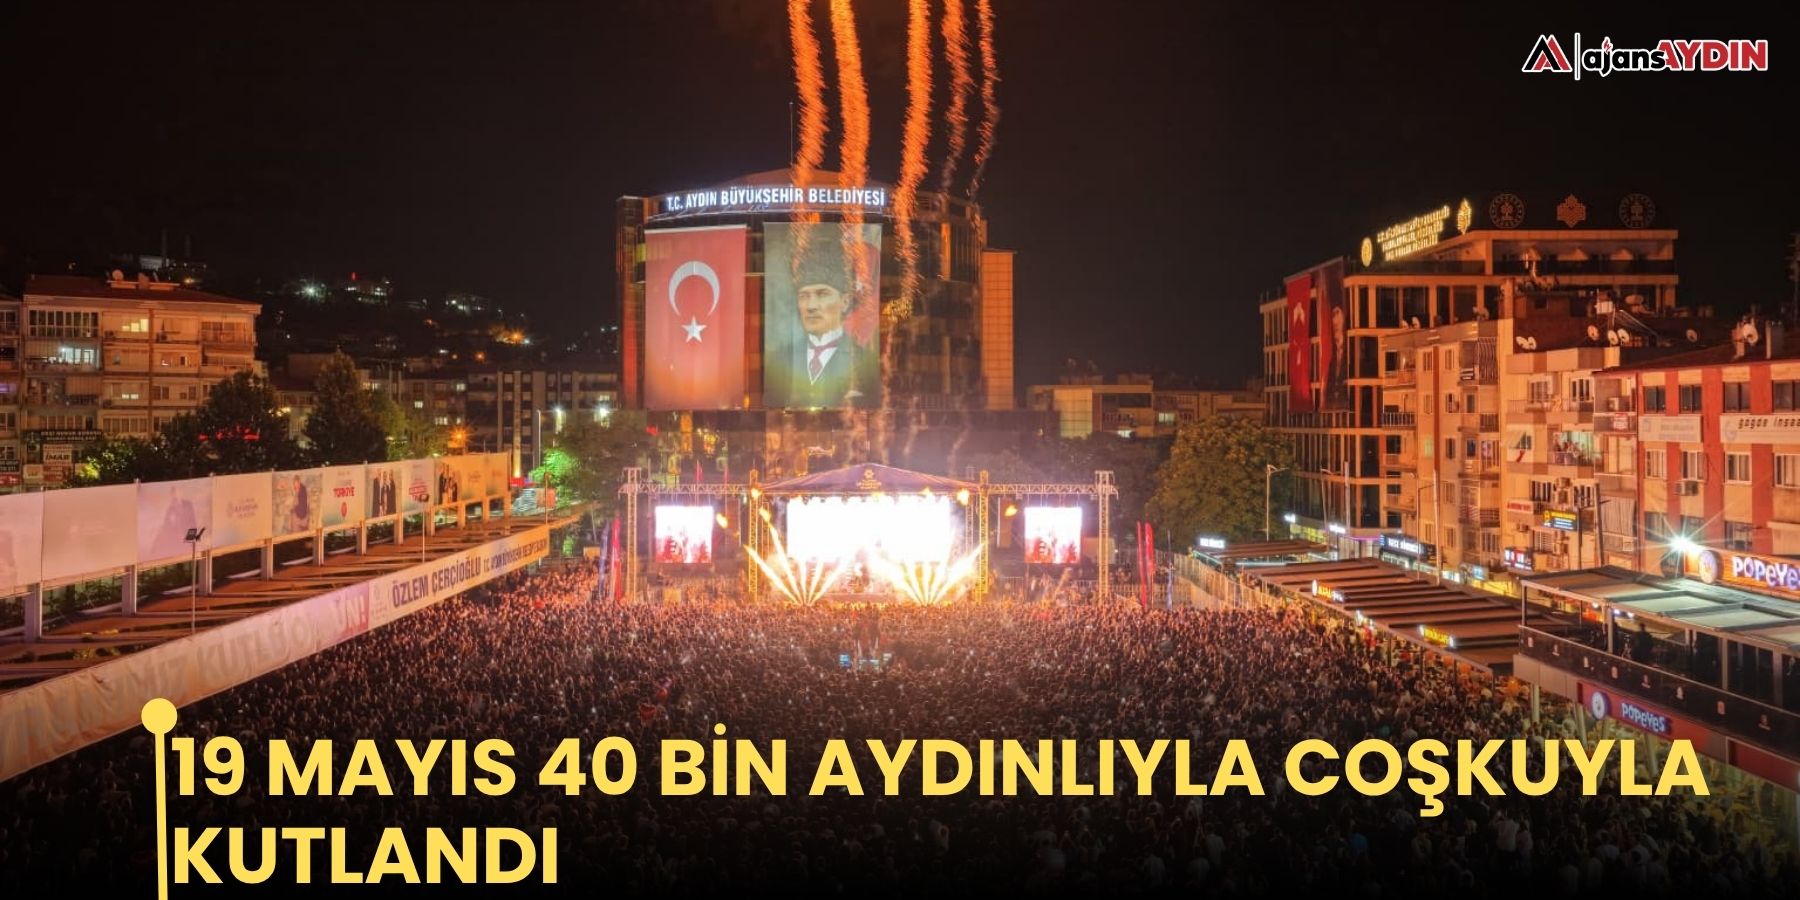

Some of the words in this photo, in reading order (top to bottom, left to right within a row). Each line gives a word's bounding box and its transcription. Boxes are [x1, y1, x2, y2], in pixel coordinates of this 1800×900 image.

[667, 196, 684, 211] T.C.
[686, 191, 718, 209] AYDIN
[721, 184, 803, 206] BÜYÜKŞEHİR
[808, 186, 885, 207] BELEDİYESİ
[392, 573, 429, 608] ÖZLEM
[432, 555, 482, 595] ÇERÇİOĞLU
